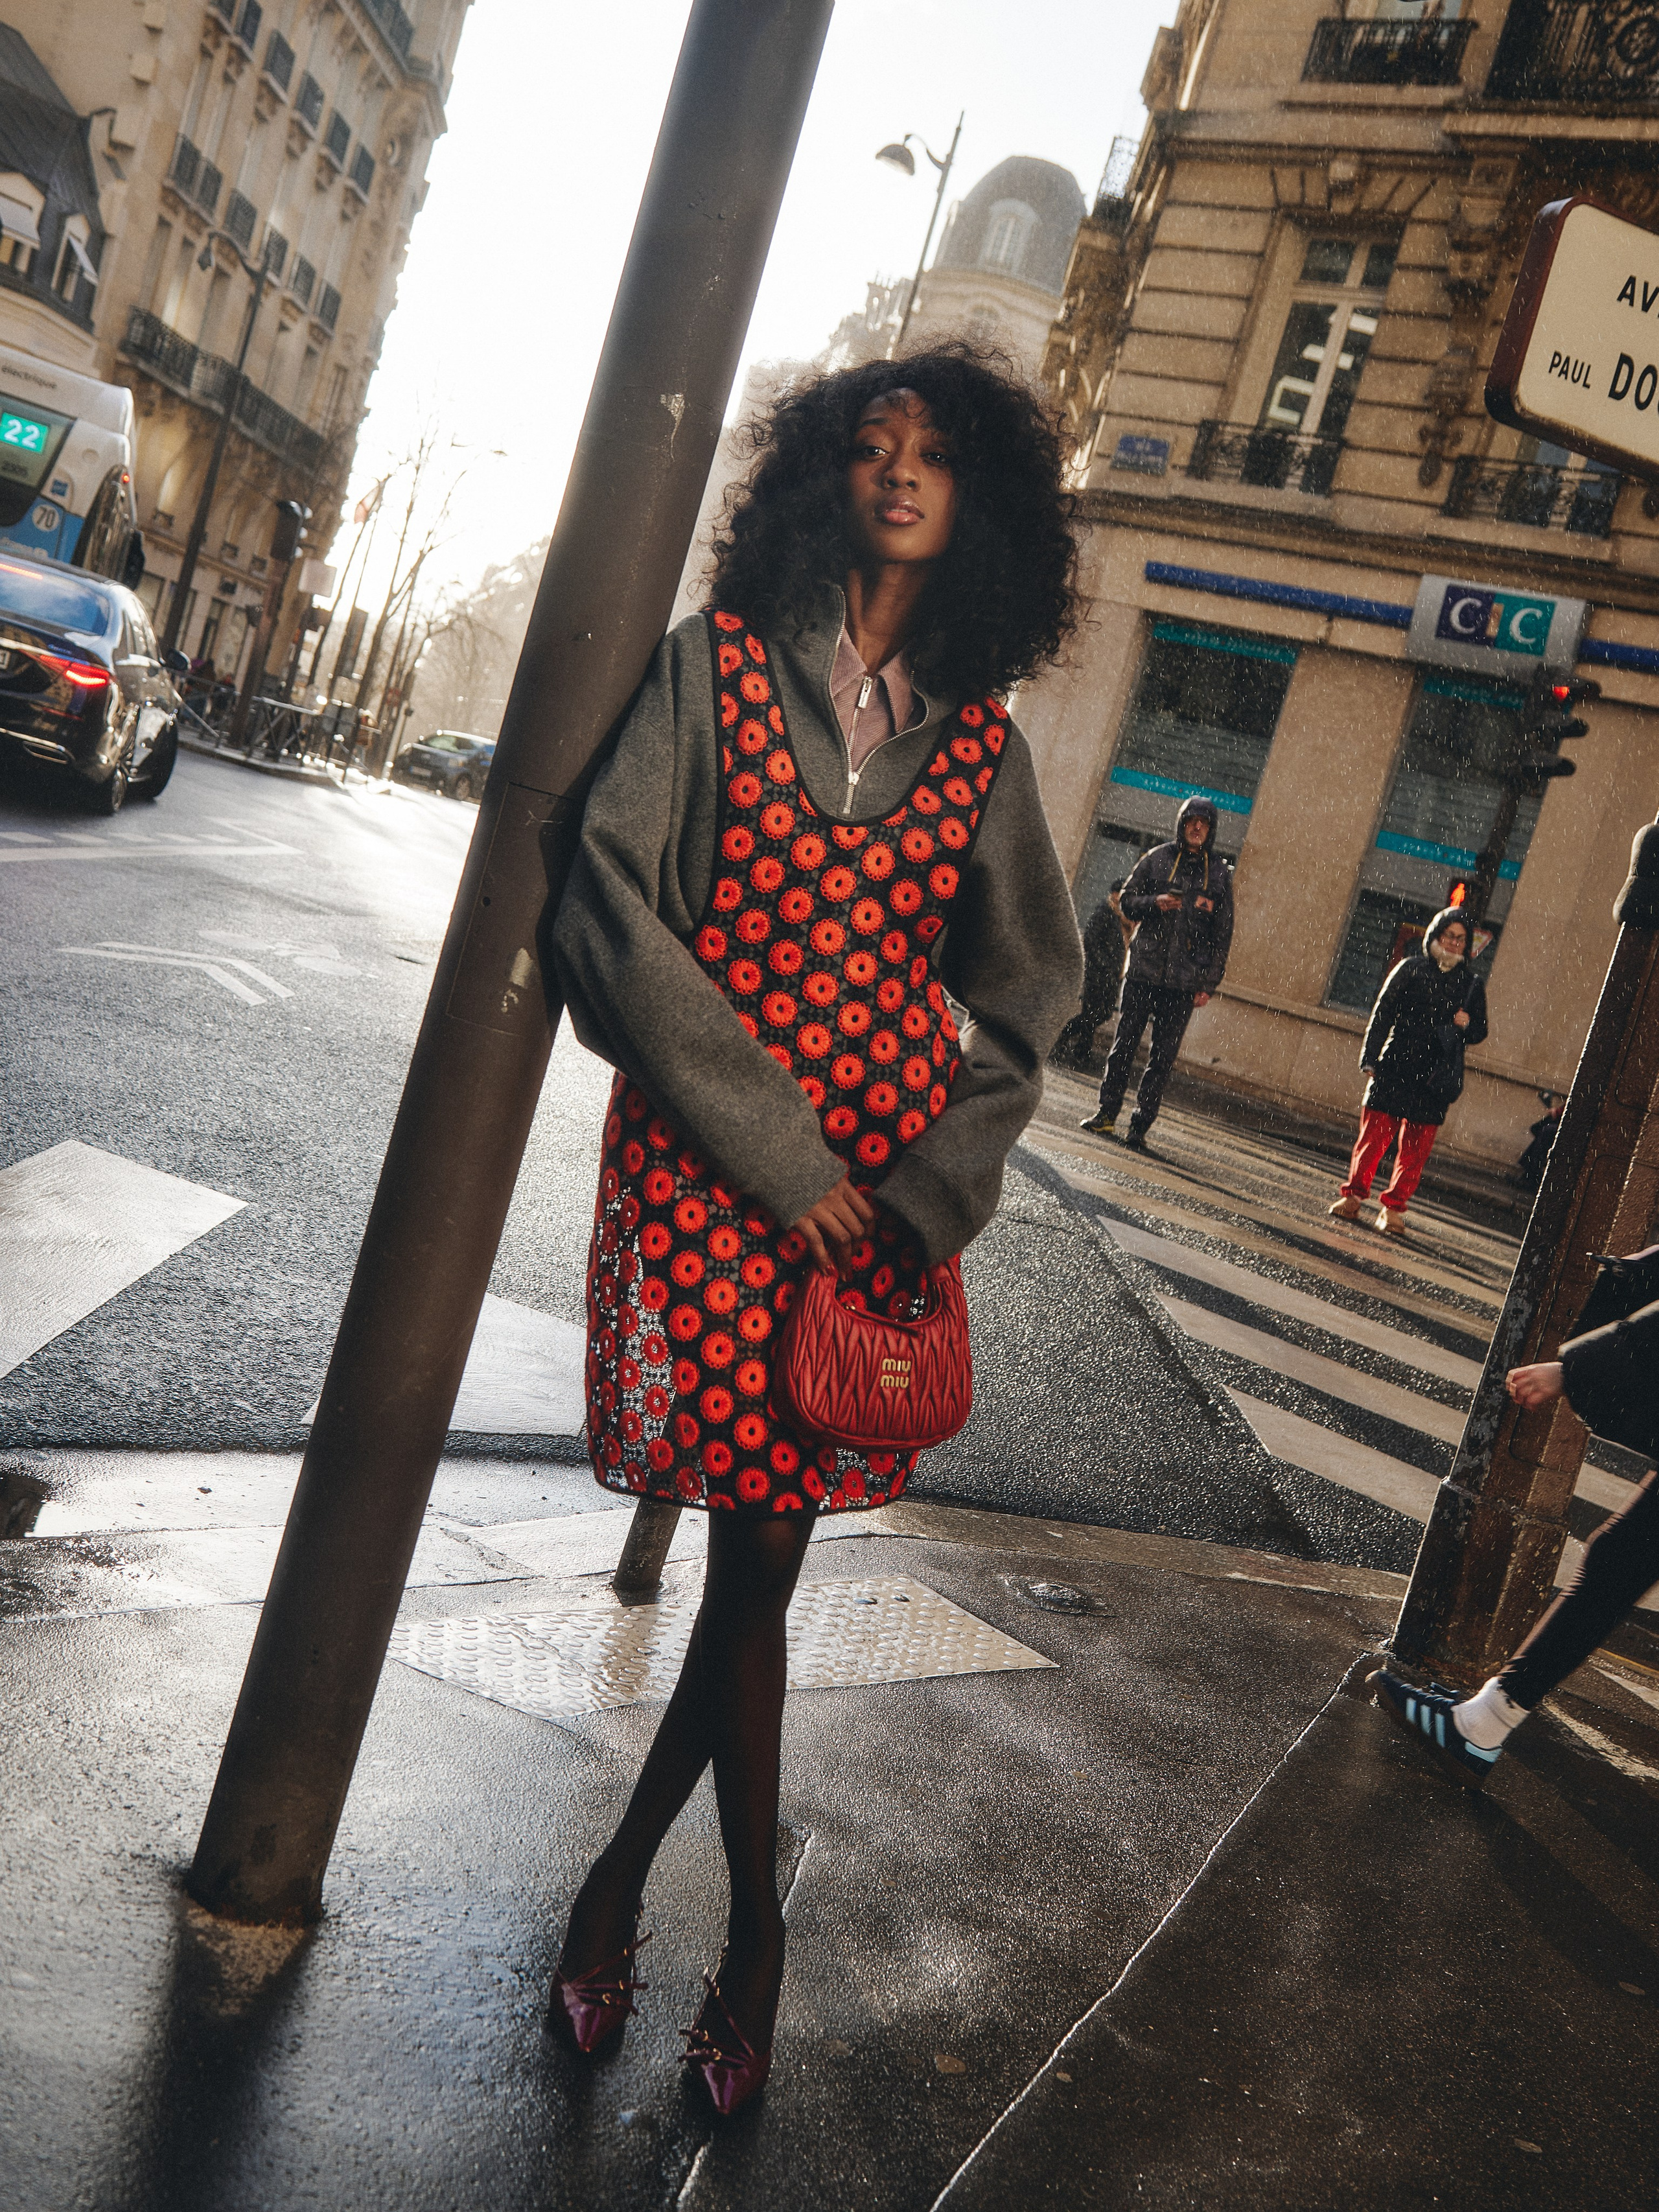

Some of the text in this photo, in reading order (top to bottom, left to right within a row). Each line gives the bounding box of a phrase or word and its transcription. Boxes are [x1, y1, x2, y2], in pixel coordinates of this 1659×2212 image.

[1616, 275, 1659, 318] AV
[1548, 351, 1659, 416] PAUL DO
[4, 419, 40, 449] 22
[36, 506, 56, 528] 70
[1449, 597, 1543, 645] CIC
